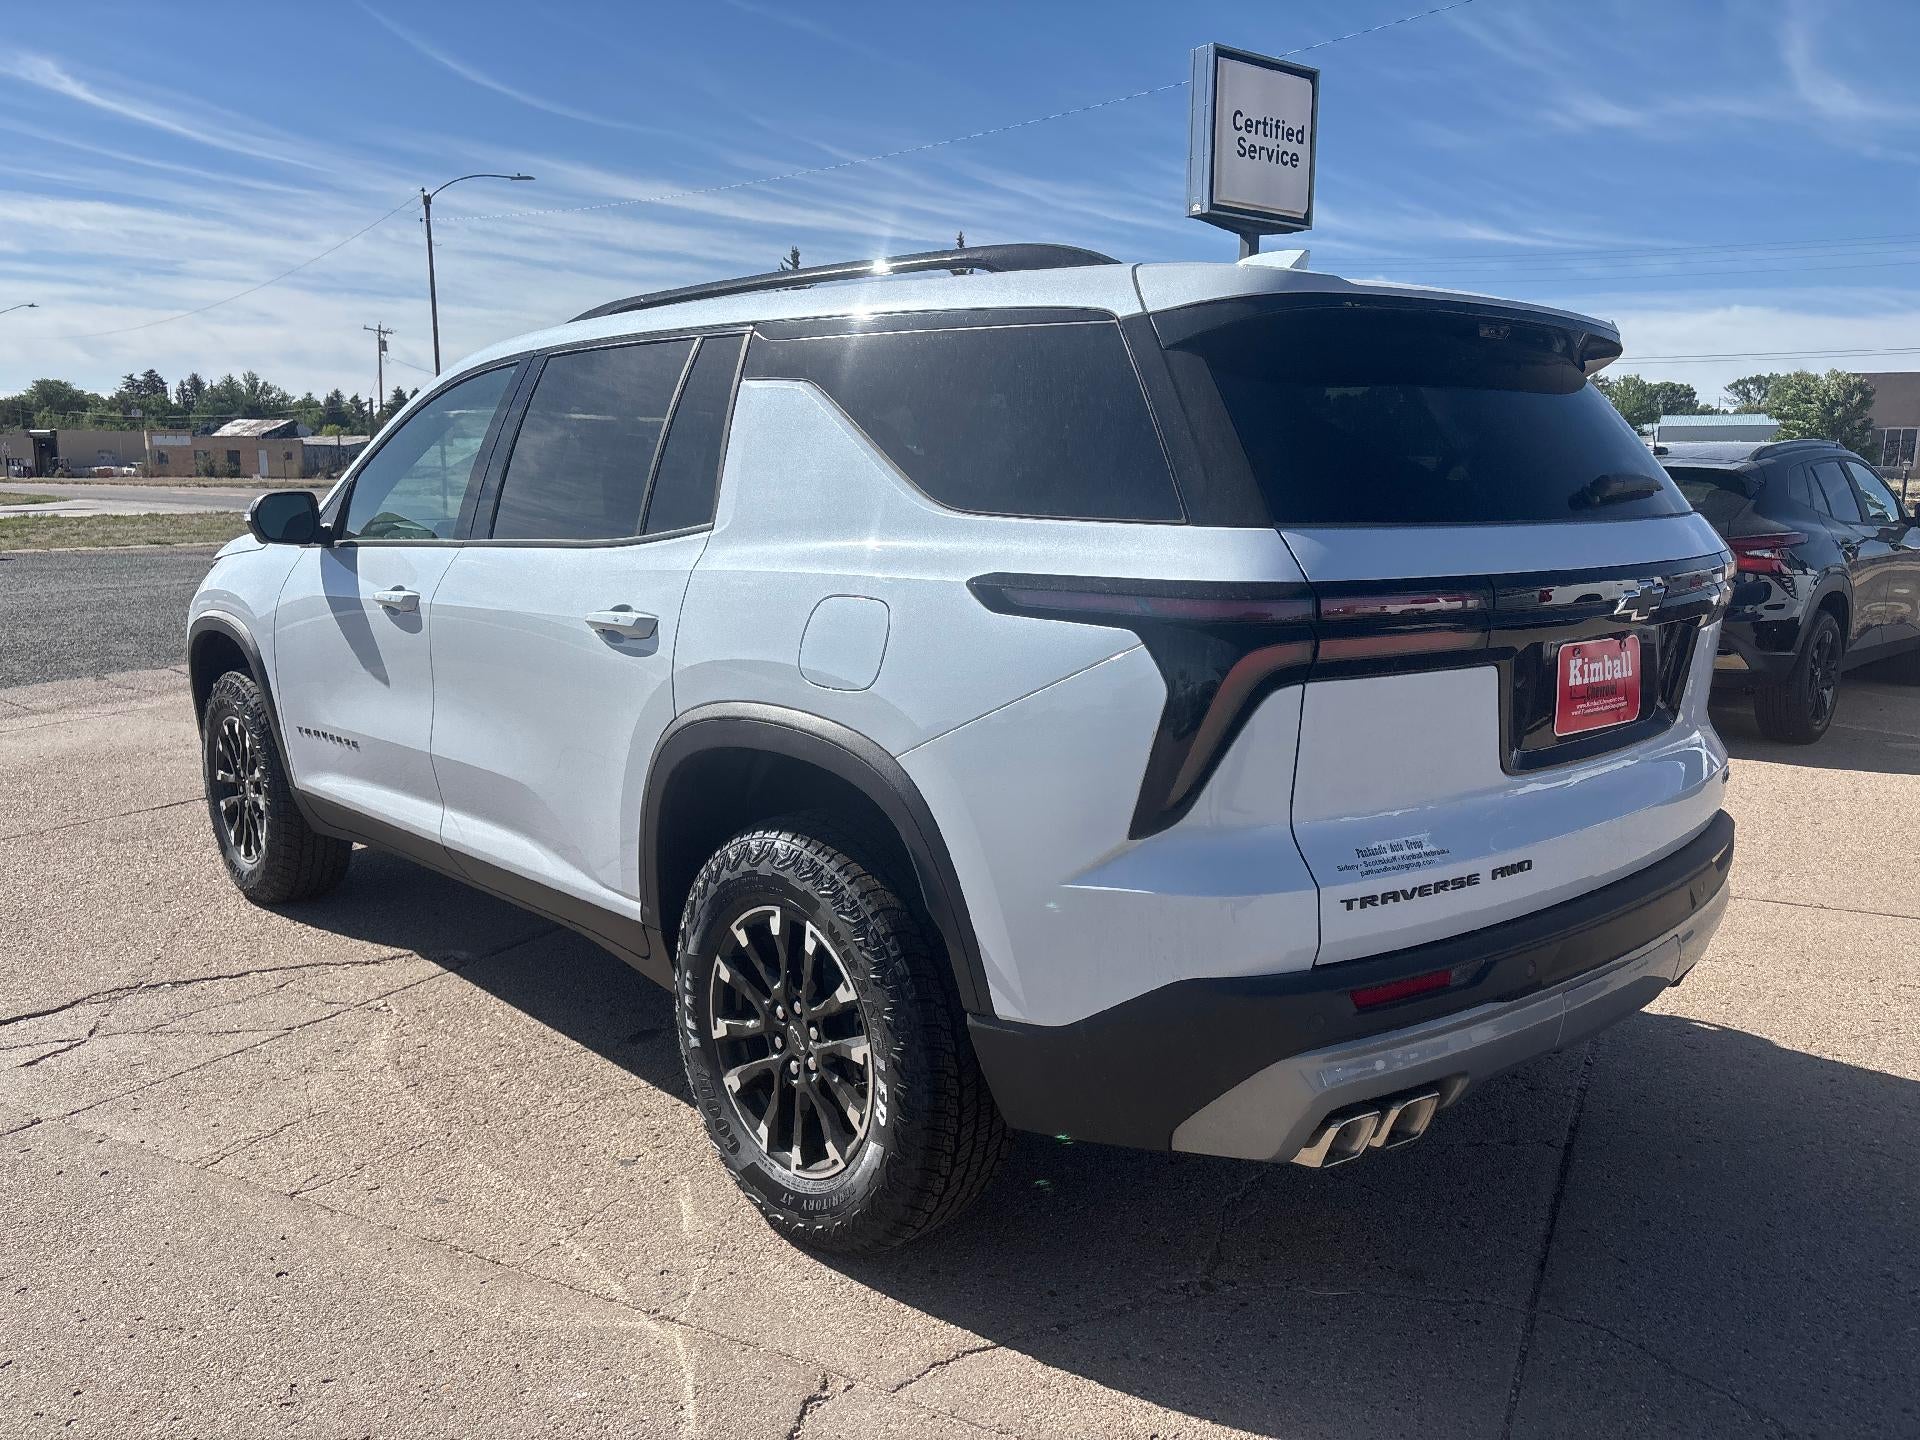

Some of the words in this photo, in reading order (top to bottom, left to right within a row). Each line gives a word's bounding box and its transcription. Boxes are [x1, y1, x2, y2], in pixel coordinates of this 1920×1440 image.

[1232, 109, 1305, 145] Certified
[1236, 136, 1300, 168] Service
[1568, 650, 1633, 687] Kimball
[296, 726, 359, 748] TRAVERSE
[1355, 845, 1388, 859] Panhandle
[1389, 842, 1404, 854] Auto
[1405, 839, 1424, 851] Group
[1340, 873, 1480, 912] TRAVERSE
[1491, 858, 1533, 881] AWD
[780, 1191, 796, 1207] AT
